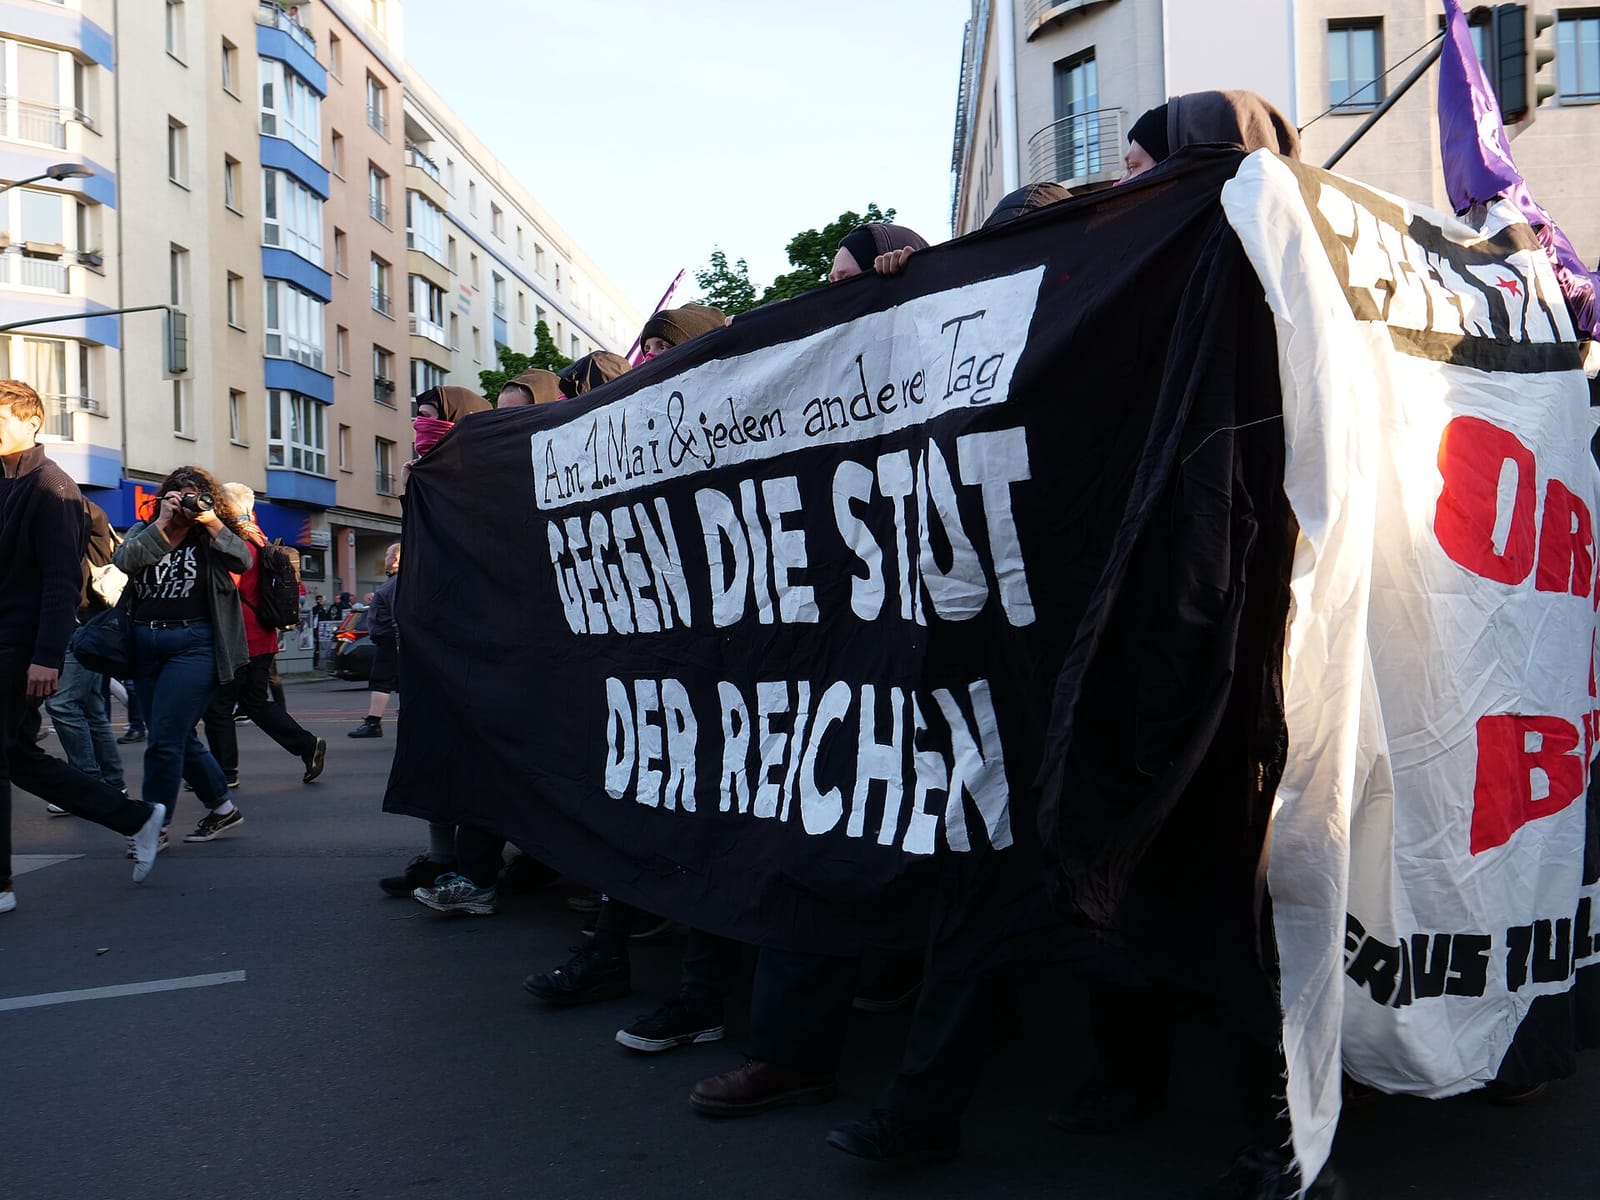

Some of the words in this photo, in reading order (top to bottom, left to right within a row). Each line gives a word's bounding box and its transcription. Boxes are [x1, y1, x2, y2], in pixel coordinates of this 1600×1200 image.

[544, 438, 584, 503] Am
[667, 391, 700, 468] &
[699, 397, 787, 469] jedem
[802, 352, 927, 437] andere
[941, 310, 1005, 404] Tag
[547, 496, 692, 635] GEGEN
[694, 476, 819, 628] DIE
[604, 677, 698, 813] DER
[717, 678, 1014, 855] REICHEN
